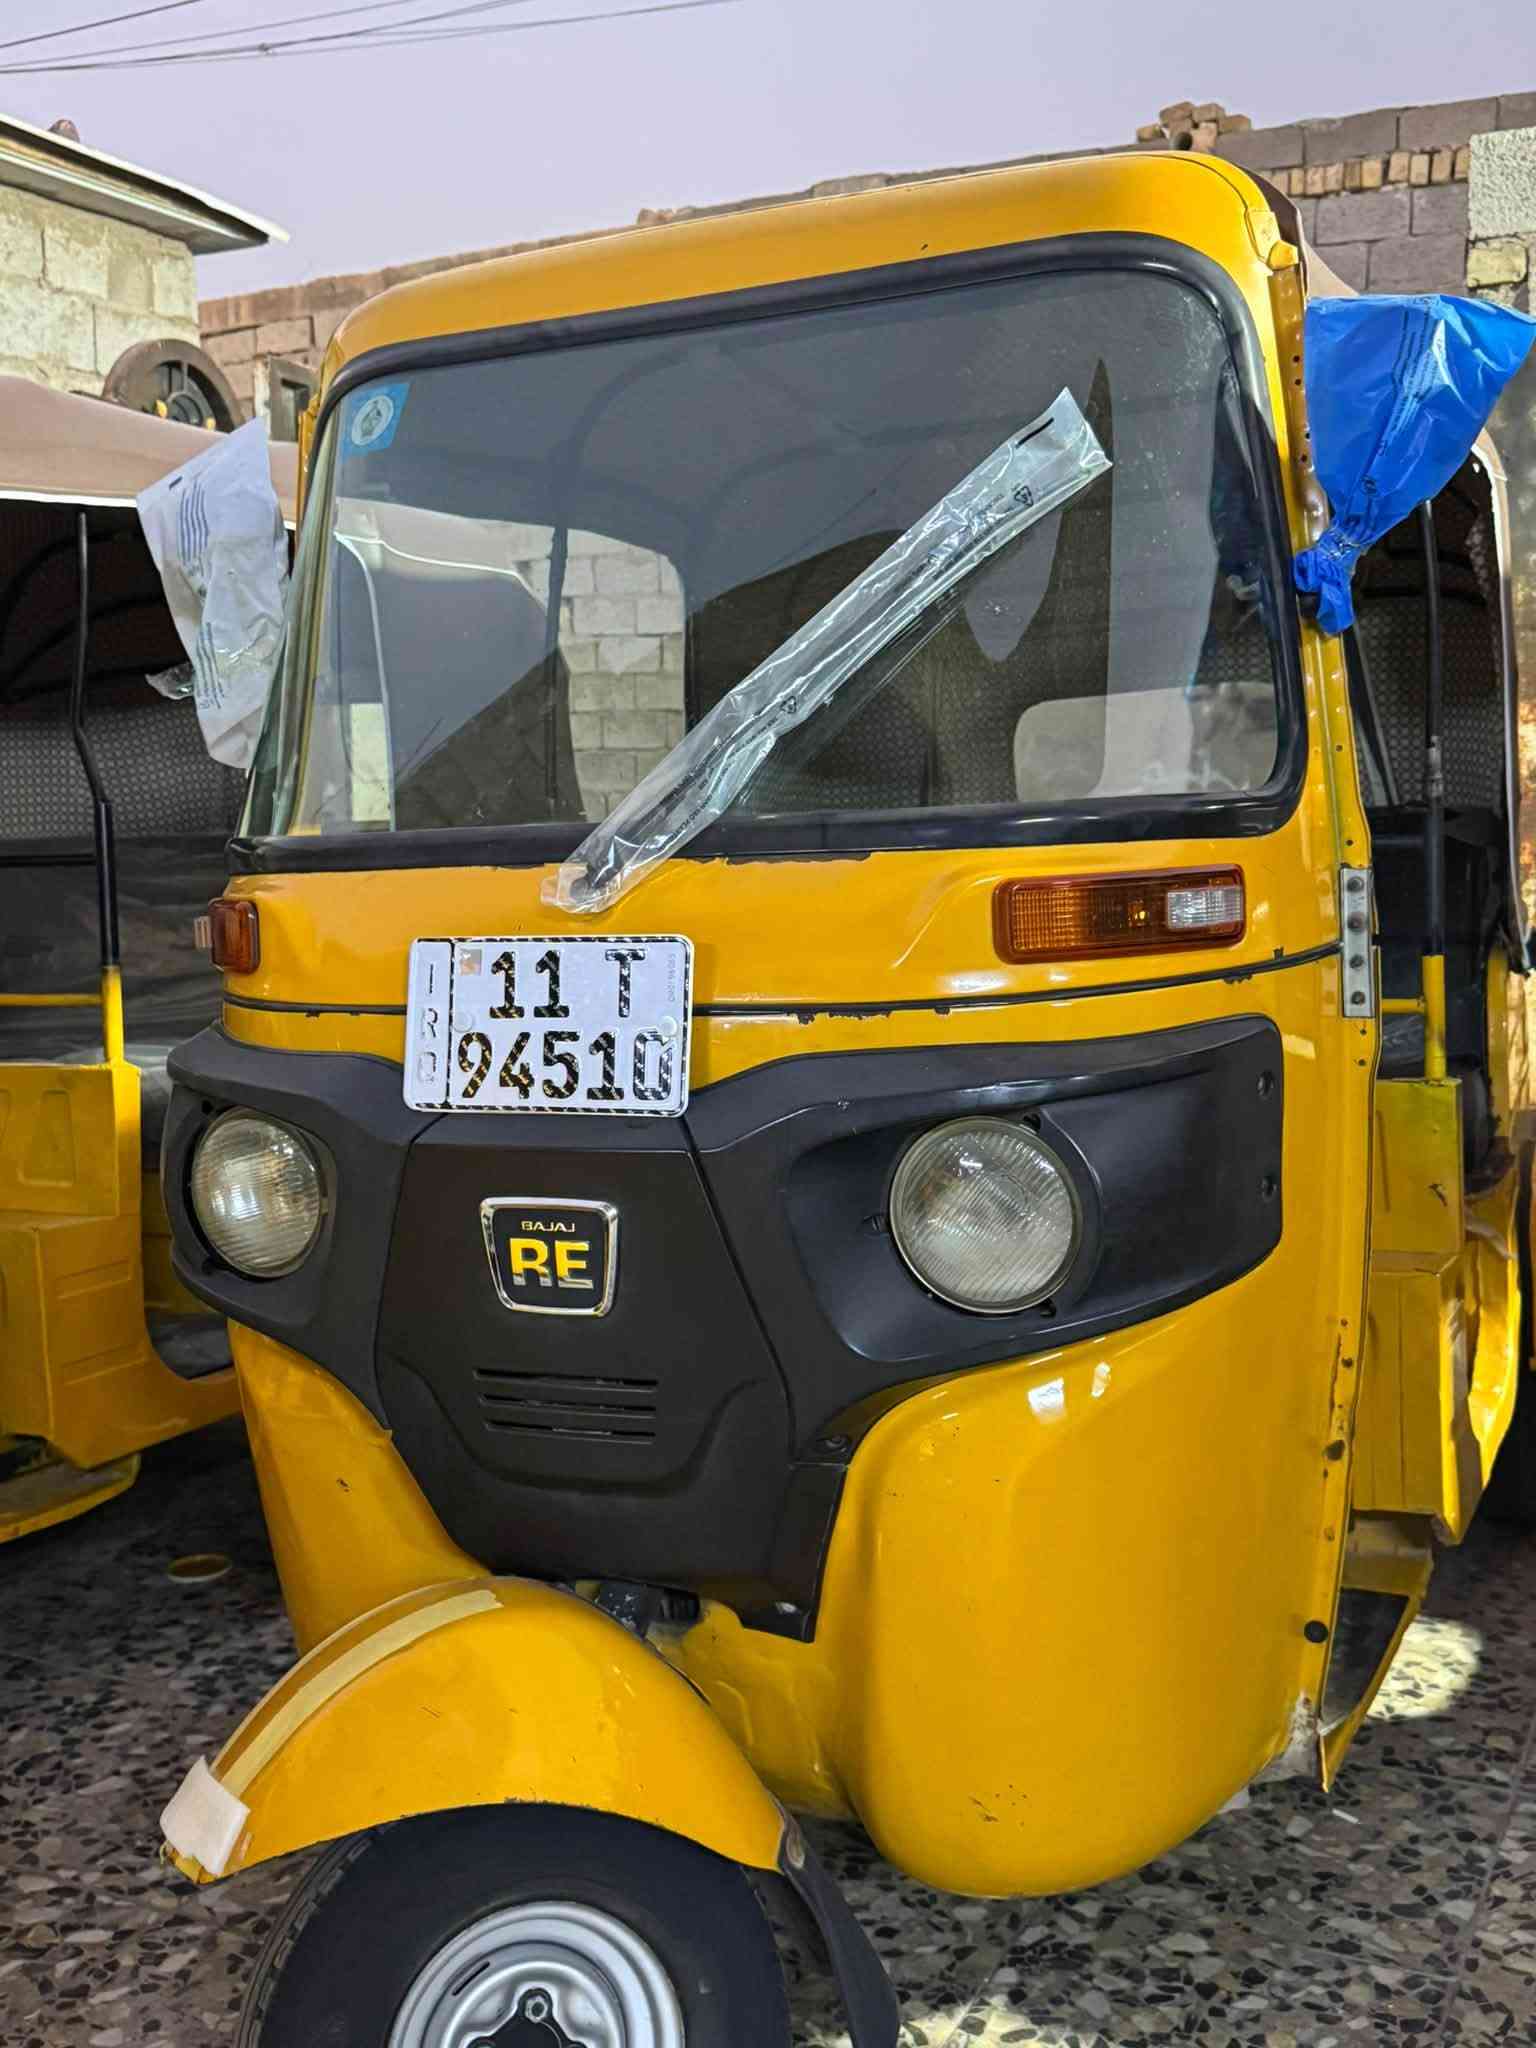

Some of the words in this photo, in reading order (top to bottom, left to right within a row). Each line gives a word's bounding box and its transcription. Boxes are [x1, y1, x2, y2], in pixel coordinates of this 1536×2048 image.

[489, 949, 570, 1019] 11
[605, 948, 649, 1018] T
[458, 1030, 674, 1101] 94510
[520, 1220, 577, 1233] BAJAJ
[509, 1237, 594, 1289] RE
